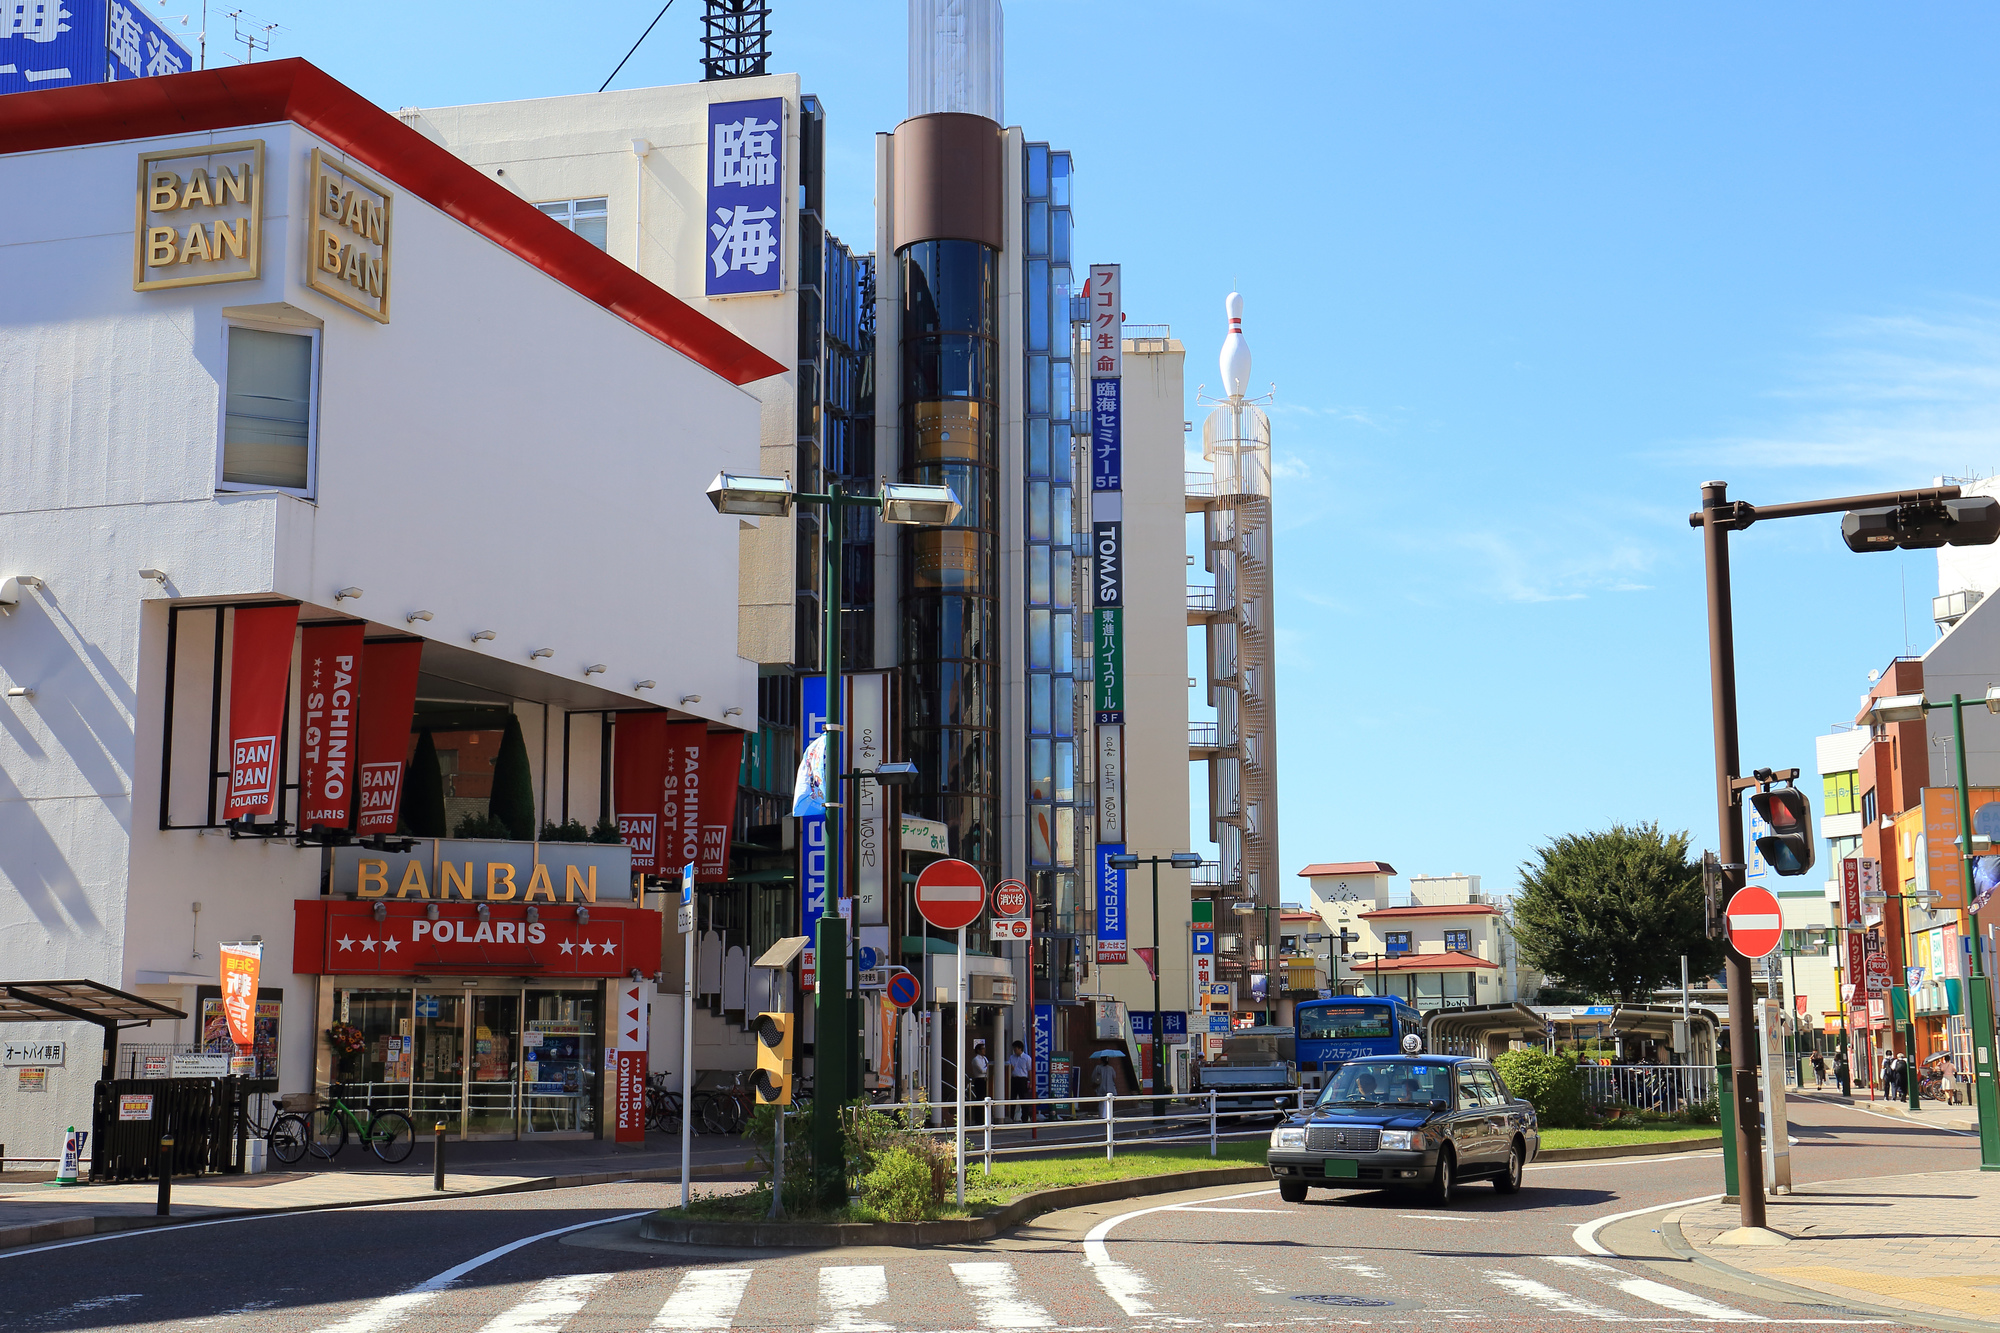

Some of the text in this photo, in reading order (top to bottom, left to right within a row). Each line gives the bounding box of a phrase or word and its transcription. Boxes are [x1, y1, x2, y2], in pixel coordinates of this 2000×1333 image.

[149, 163, 250, 213] BAN
[710, 117, 779, 278] 臨海
[319, 175, 384, 245] BAN
[147, 218, 248, 268] BAN
[318, 230, 383, 298] BAN
[1096, 272, 1116, 372] フコク生命
[1096, 382, 1116, 474] 臨海セミナー
[1096, 476, 1118, 488] 5F
[1099, 526, 1118, 602] TOMAS
[1102, 610, 1116, 709] 東進ハイスクール
[306, 656, 354, 800] PACHINKO SLOT
[236, 744, 270, 766] BAN
[234, 767, 266, 788] BAN
[362, 770, 396, 787] BAN
[230, 794, 268, 808] POLARIS
[664, 746, 699, 860] PACHINKO SLOT
[619, 820, 652, 834] BAN
[703, 832, 722, 844] AN
[702, 847, 720, 860] AN
[1928, 824, 1943, 872] SLOT
[1940, 794, 1960, 901] PACHINKO
[702, 867, 723, 875] LARIS
[862, 894, 872, 904] 2F
[1000, 894, 1024, 906] 消火栓
[412, 920, 546, 944] POLARIS
[6, 1046, 60, 1060] オートバイ専用
[1318, 1048, 1373, 1060] ノンステップバス
[619, 1058, 642, 1128] PACHINKO SLOT
